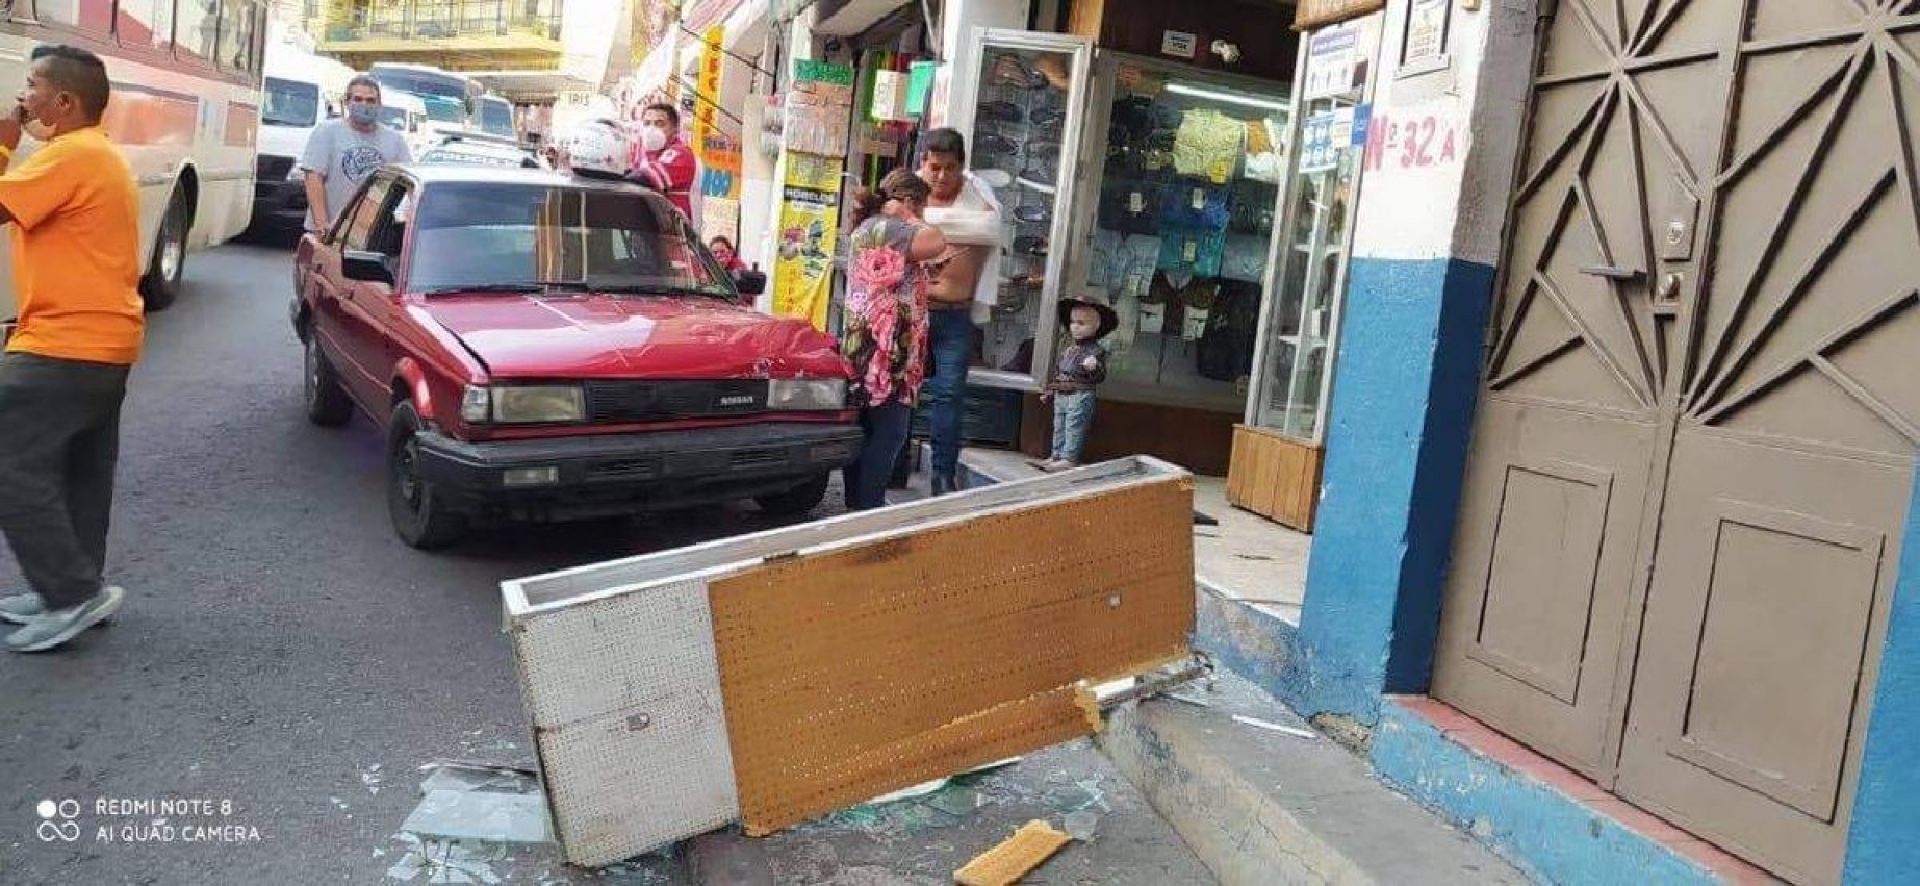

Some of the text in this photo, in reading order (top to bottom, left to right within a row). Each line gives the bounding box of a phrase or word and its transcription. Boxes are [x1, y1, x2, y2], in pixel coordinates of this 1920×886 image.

[1401, 116, 1436, 169] 32
[1440, 127, 1456, 163] A
[721, 396, 753, 406] NISSAN
